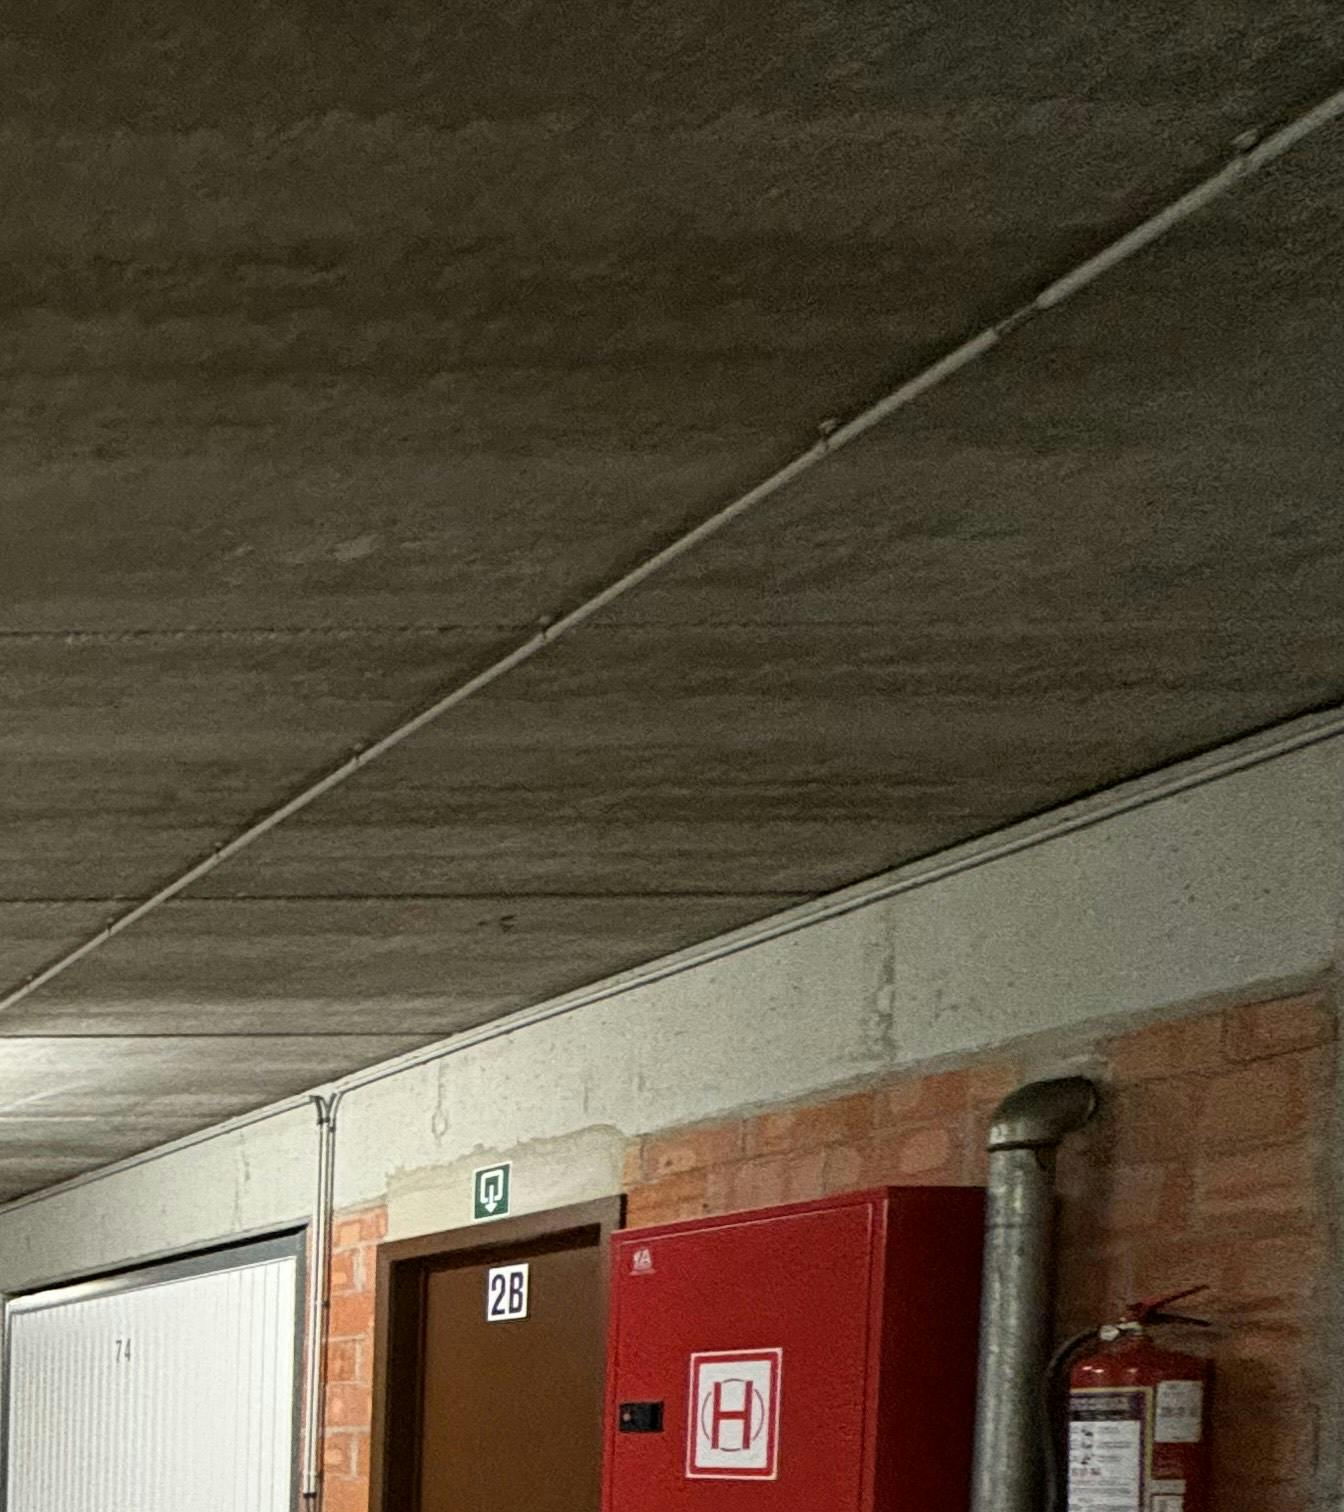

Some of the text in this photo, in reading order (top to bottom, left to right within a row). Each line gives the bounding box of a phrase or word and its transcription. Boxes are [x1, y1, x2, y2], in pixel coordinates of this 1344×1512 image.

[490, 1271, 524, 1316] 2B
[115, 1338, 131, 1363] 74
[711, 1380, 753, 1450] H
